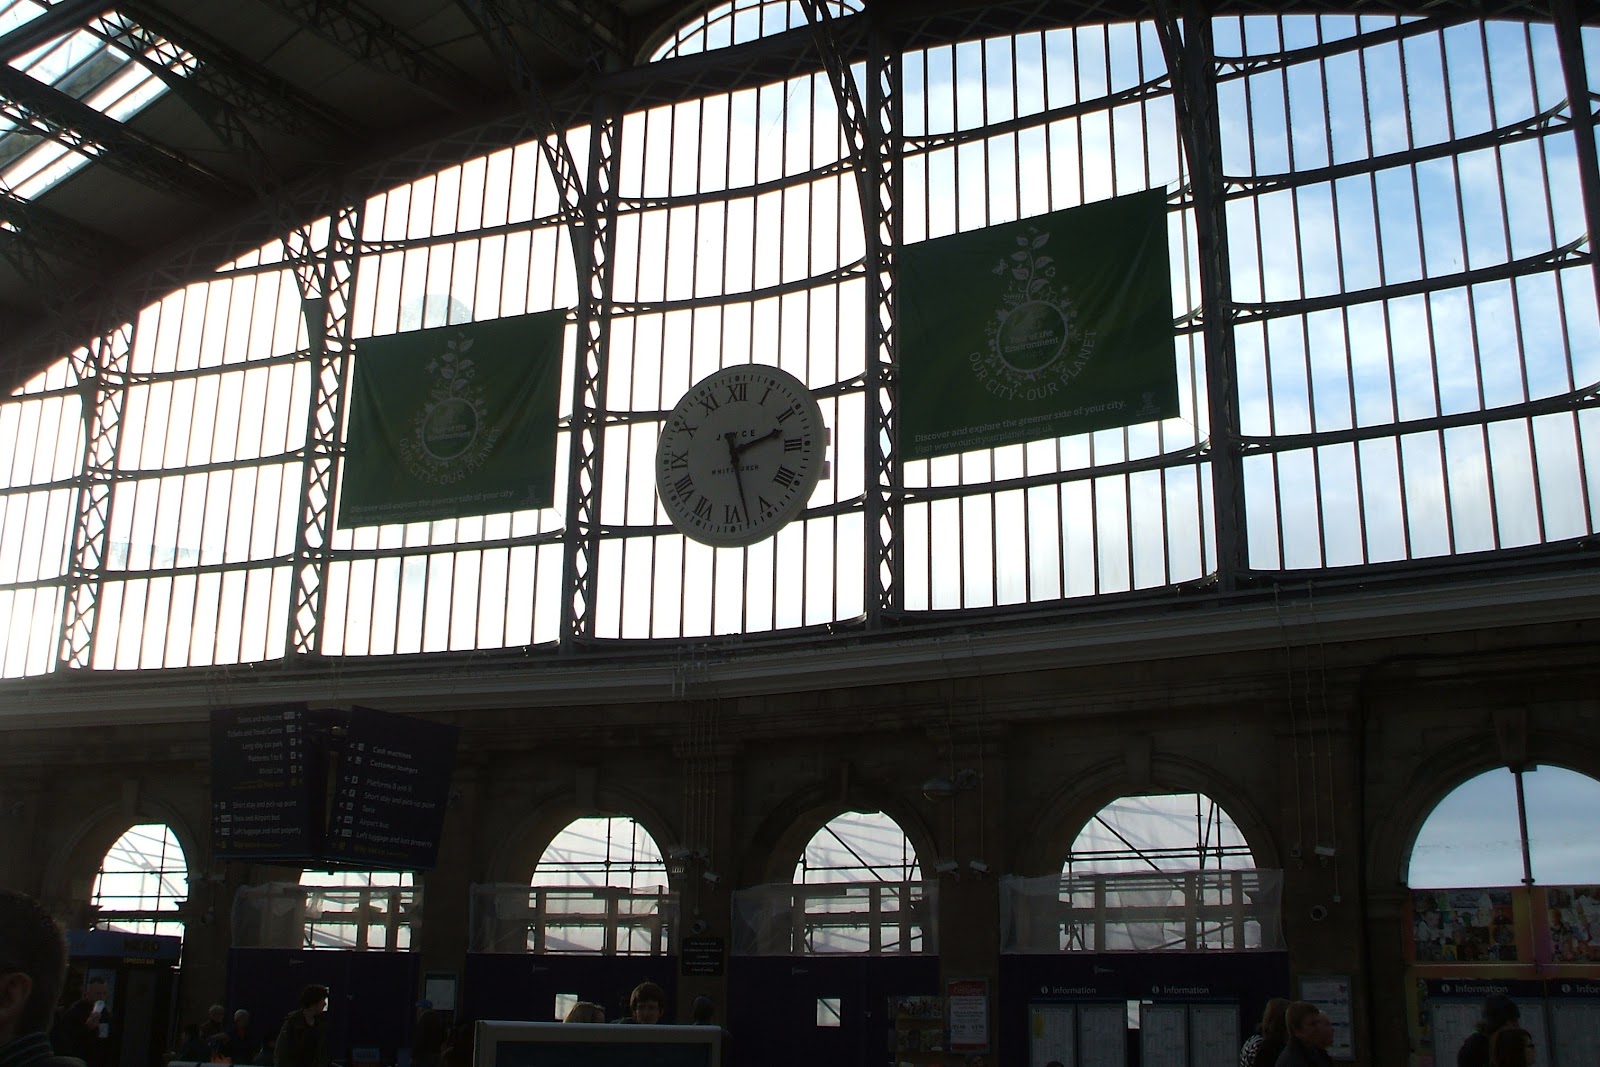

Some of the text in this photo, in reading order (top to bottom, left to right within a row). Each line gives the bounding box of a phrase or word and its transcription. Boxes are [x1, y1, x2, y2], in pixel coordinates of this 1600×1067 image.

[1029, 330, 1038, 342] of
[1039, 328, 1054, 339] the
[1005, 337, 1059, 353] Environment
[969, 329, 1097, 401] OUR CITY OUR PLANET
[726, 382, 748, 404] XII
[758, 387, 772, 406] I
[697, 392, 721, 418] XI
[776, 405, 796, 425] II
[914, 400, 1127, 443] Discover and explore the greener side of your city.
[677, 419, 699, 440] X
[716, 429, 756, 441] JYCE
[783, 437, 802, 454] III
[671, 449, 689, 470] IX
[440, 470, 465, 485] OUR
[711, 464, 760, 476] WHITCURCH
[772, 464, 796, 489] IIII
[674, 472, 697, 505] VIII
[692, 495, 713, 521] VII
[758, 495, 772, 514] V
[724, 504, 742, 524] VI
[373, 746, 412, 760] Cash machines
[370, 759, 418, 774] Customer lounges
[367, 778, 391, 789] Platforms
[233, 801, 245, 809] Short
[245, 801, 256, 809] stay
[363, 791, 379, 801] Short
[380, 795, 391, 804] stay
[391, 796, 401, 804] and
[421, 801, 435, 809] point
[254, 814, 271, 822] Airport
[359, 818, 379, 827] Airport
[280, 826, 301, 836] property
[356, 831, 432, 848] Left luggage and lost property
[1052, 985, 1096, 995] Information
[1163, 985, 1209, 995] Information
[1455, 984, 1508, 993] Information
